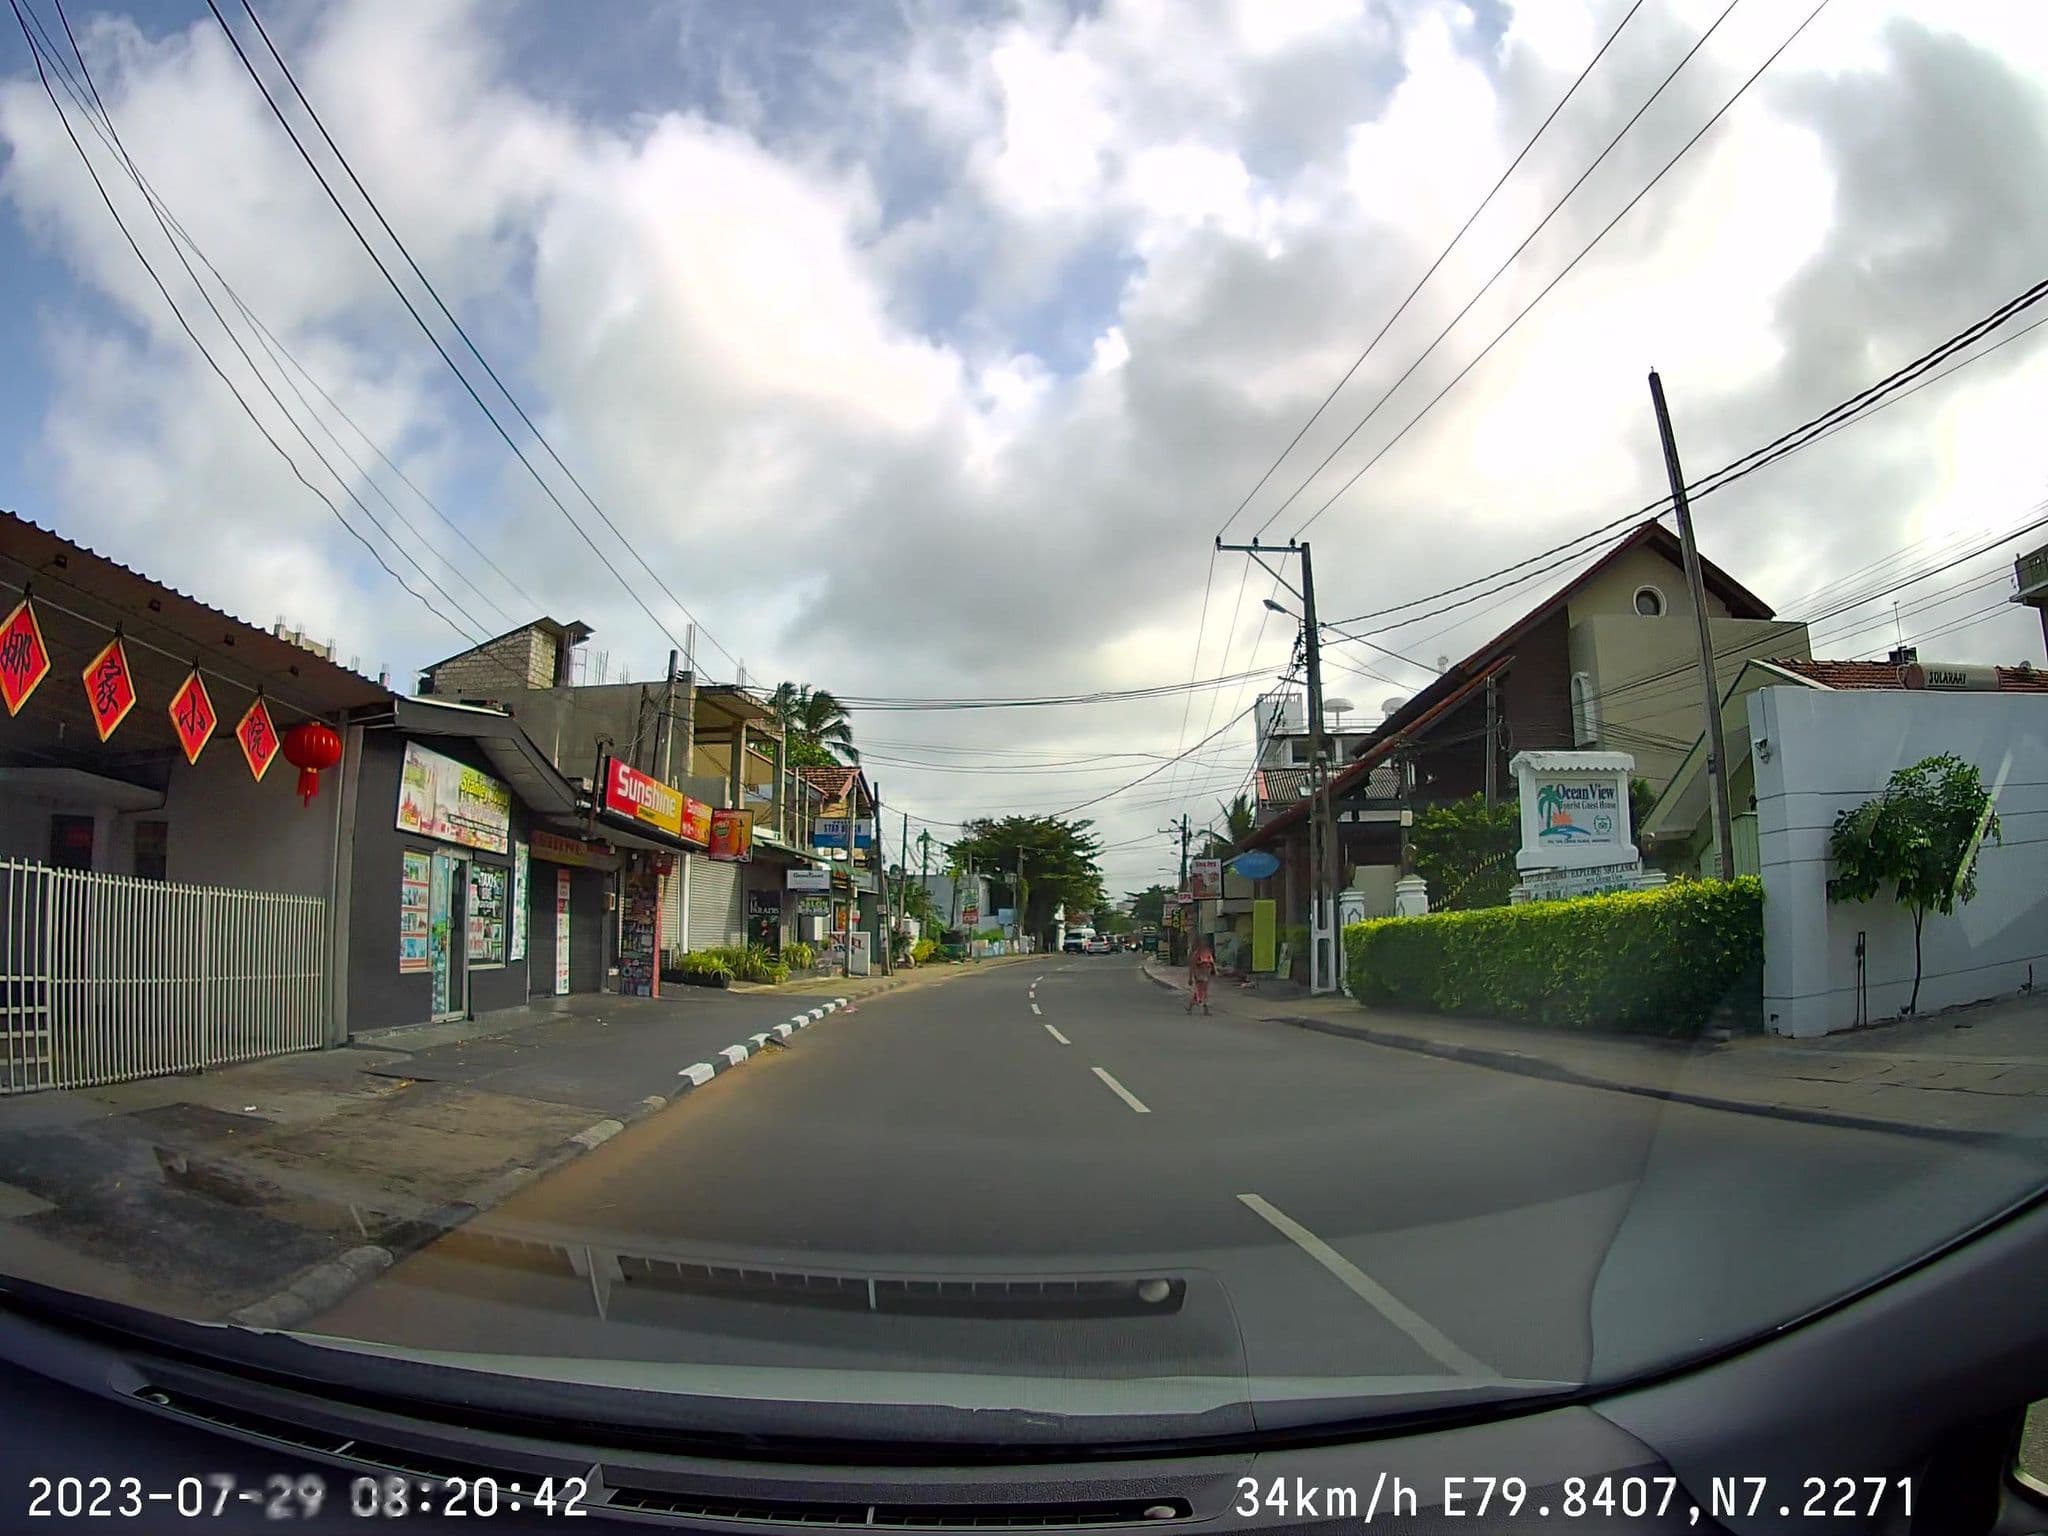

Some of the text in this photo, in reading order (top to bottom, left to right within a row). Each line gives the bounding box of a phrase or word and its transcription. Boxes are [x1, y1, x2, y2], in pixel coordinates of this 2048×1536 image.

[617, 764, 677, 818] Sunshine
[1556, 783, 1615, 800] Ocean View
